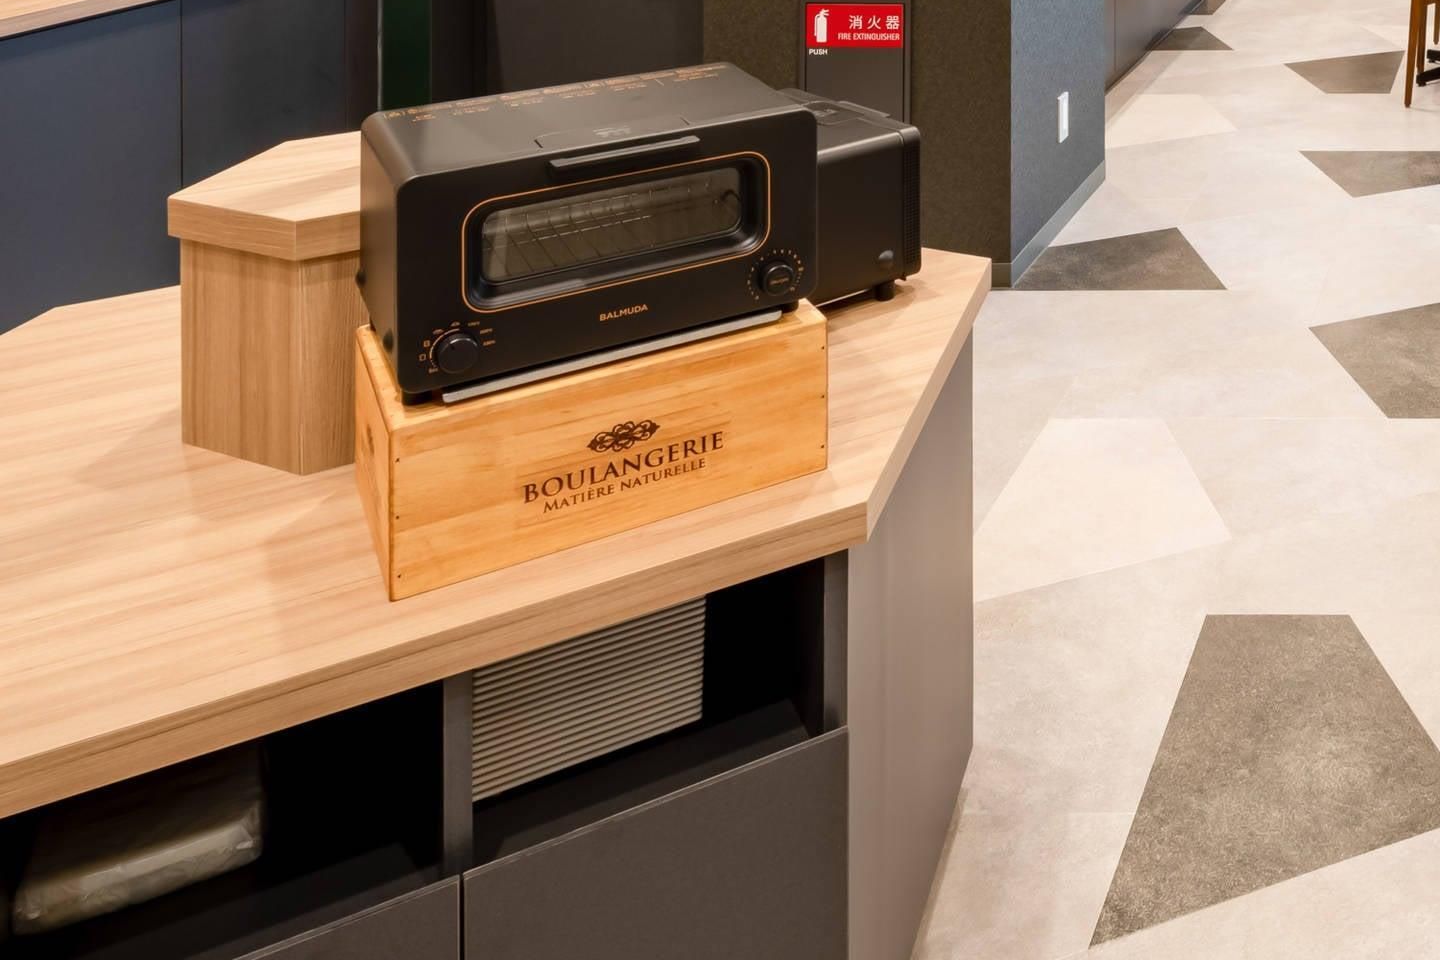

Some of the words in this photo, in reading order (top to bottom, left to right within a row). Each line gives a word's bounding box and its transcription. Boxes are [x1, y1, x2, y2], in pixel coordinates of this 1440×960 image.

[849, 15, 900, 30] 消火器
[837, 32, 852, 41] FIRE
[853, 32, 900, 41] EXTINGUISHER
[808, 48, 828, 56] PUSH
[600, 303, 649, 321] BALMUDA
[523, 431, 724, 504] BOULANGERIE
[543, 483, 615, 514] MATIÈRE
[620, 458, 706, 492] NATURELLE
